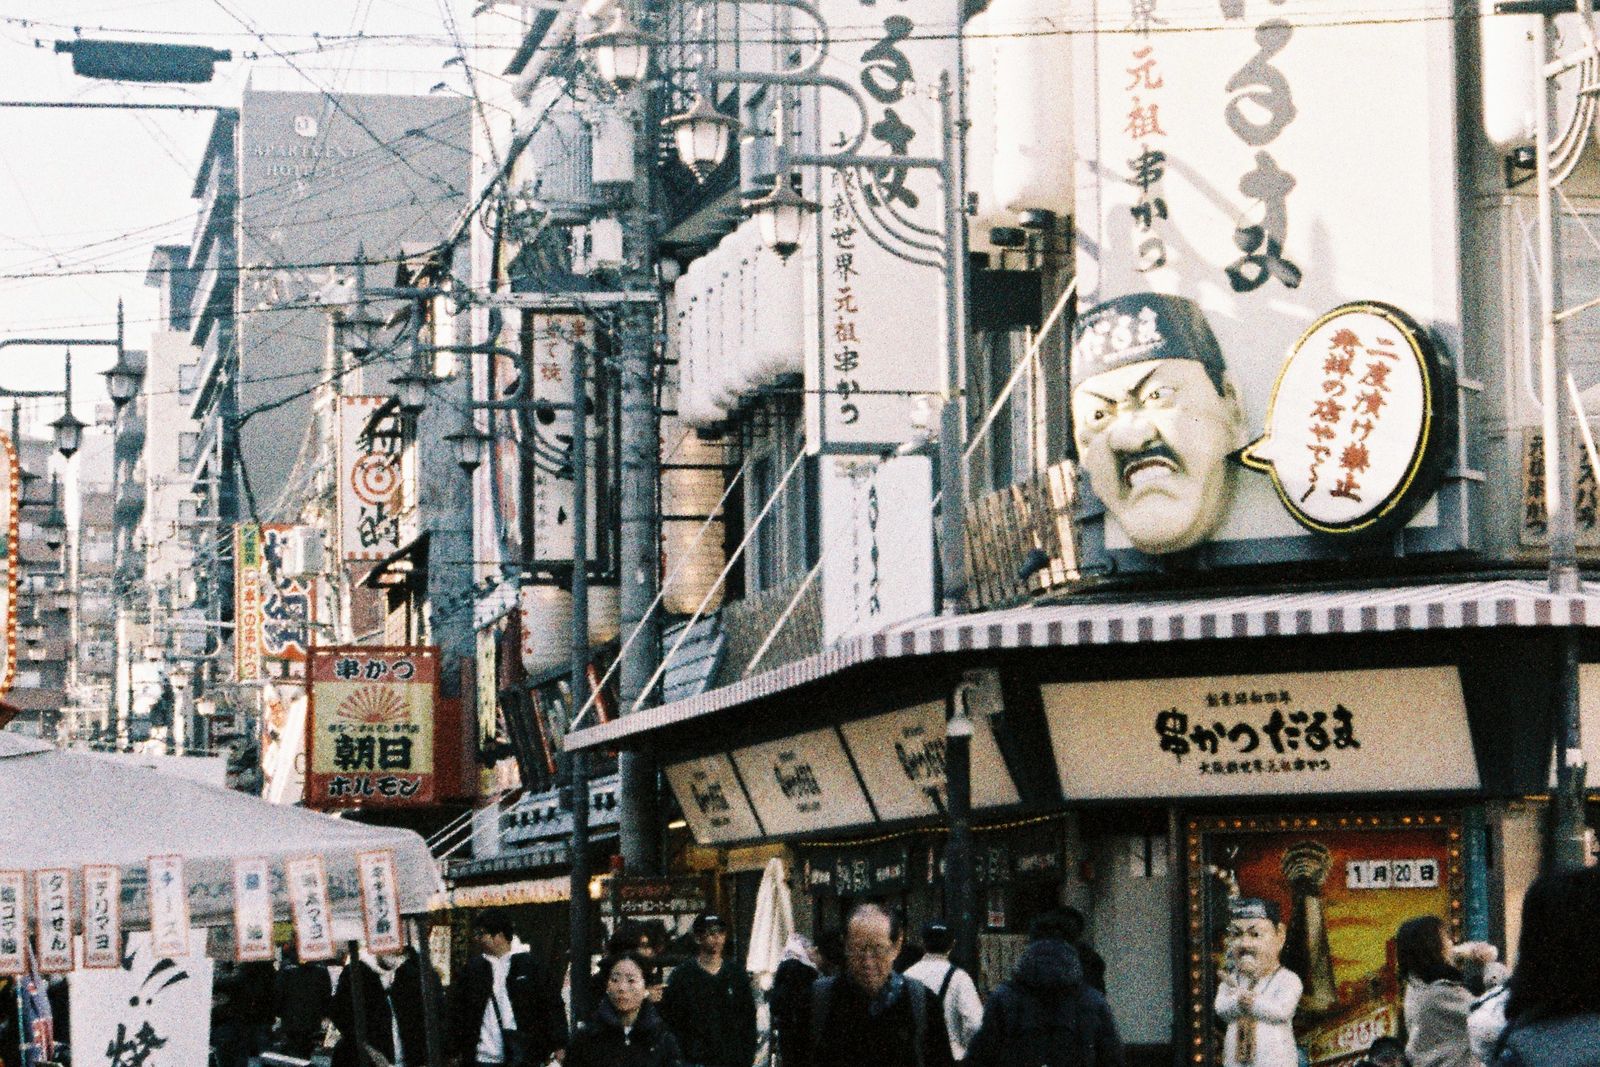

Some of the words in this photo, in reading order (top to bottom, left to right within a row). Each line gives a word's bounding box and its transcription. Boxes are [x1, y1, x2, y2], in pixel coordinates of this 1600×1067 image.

[1331, 336, 1400, 502] 二度漬け禁止
[336, 658, 415, 679] 串かつ
[333, 733, 413, 770] 朝日
[328, 775, 420, 796] ホルモン
[49, 874, 67, 951] タコせん
[95, 881, 109, 950] テリマヨ
